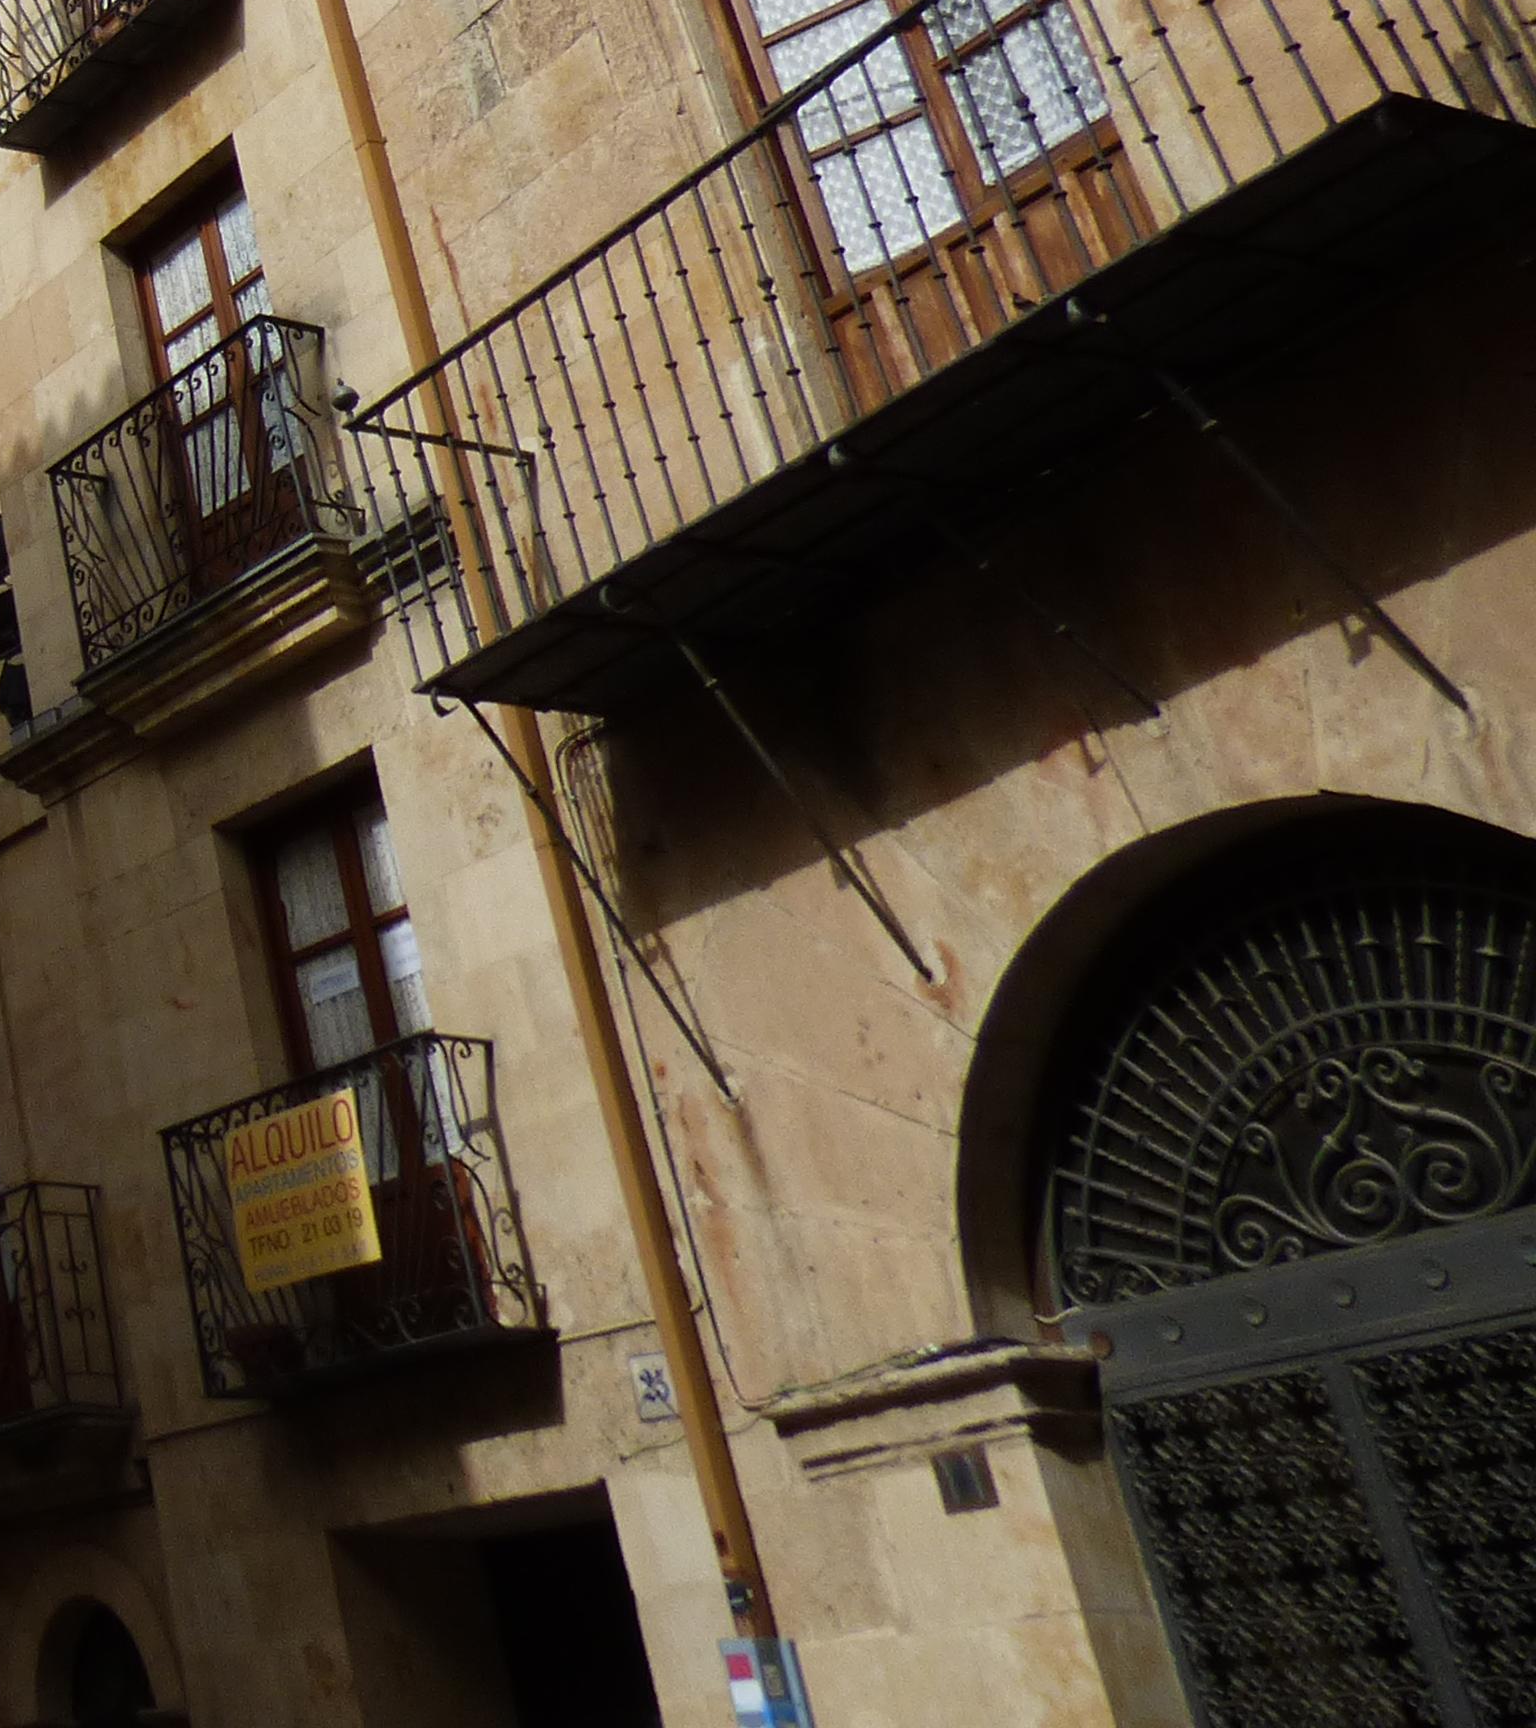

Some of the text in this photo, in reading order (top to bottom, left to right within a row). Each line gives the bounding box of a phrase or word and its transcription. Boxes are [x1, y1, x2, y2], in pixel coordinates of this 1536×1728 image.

[230, 1098, 354, 1179] ALQUILO
[245, 1176, 362, 1232] AMUEBLADOS
[301, 1223, 320, 1244] 21
[346, 1207, 365, 1230] 19
